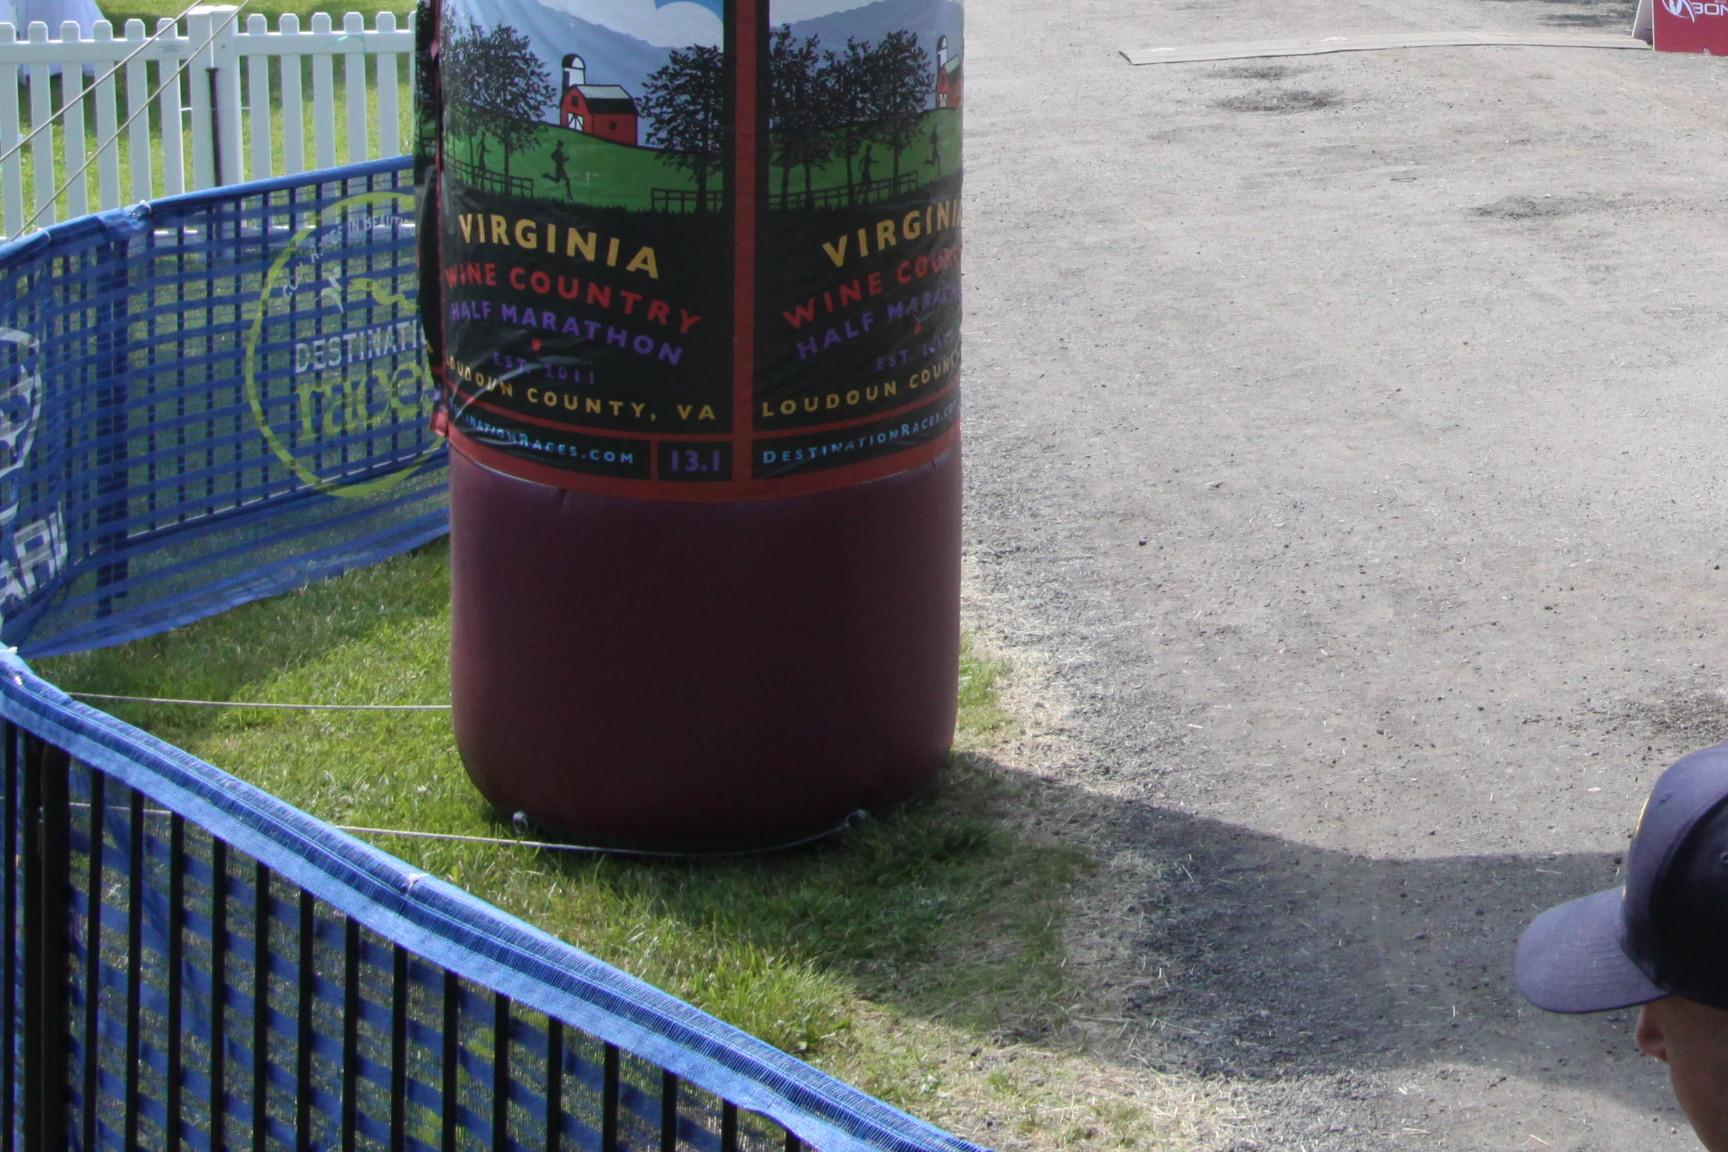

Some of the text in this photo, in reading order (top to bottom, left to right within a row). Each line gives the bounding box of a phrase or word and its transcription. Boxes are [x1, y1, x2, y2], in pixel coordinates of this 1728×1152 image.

[459, 213, 659, 279] VIRGINIA
[444, 262, 704, 334] WINE COUNTRY
[783, 271, 882, 329] WINE
[295, 319, 428, 374] DESTINATI
[451, 300, 683, 366] HALF MARATHON
[797, 312, 874, 360] HALF
[447, 356, 715, 422] OUDOUN COUNTY, VA
[762, 381, 897, 417] LOUDOUN
[670, 450, 720, 472] 13.1
